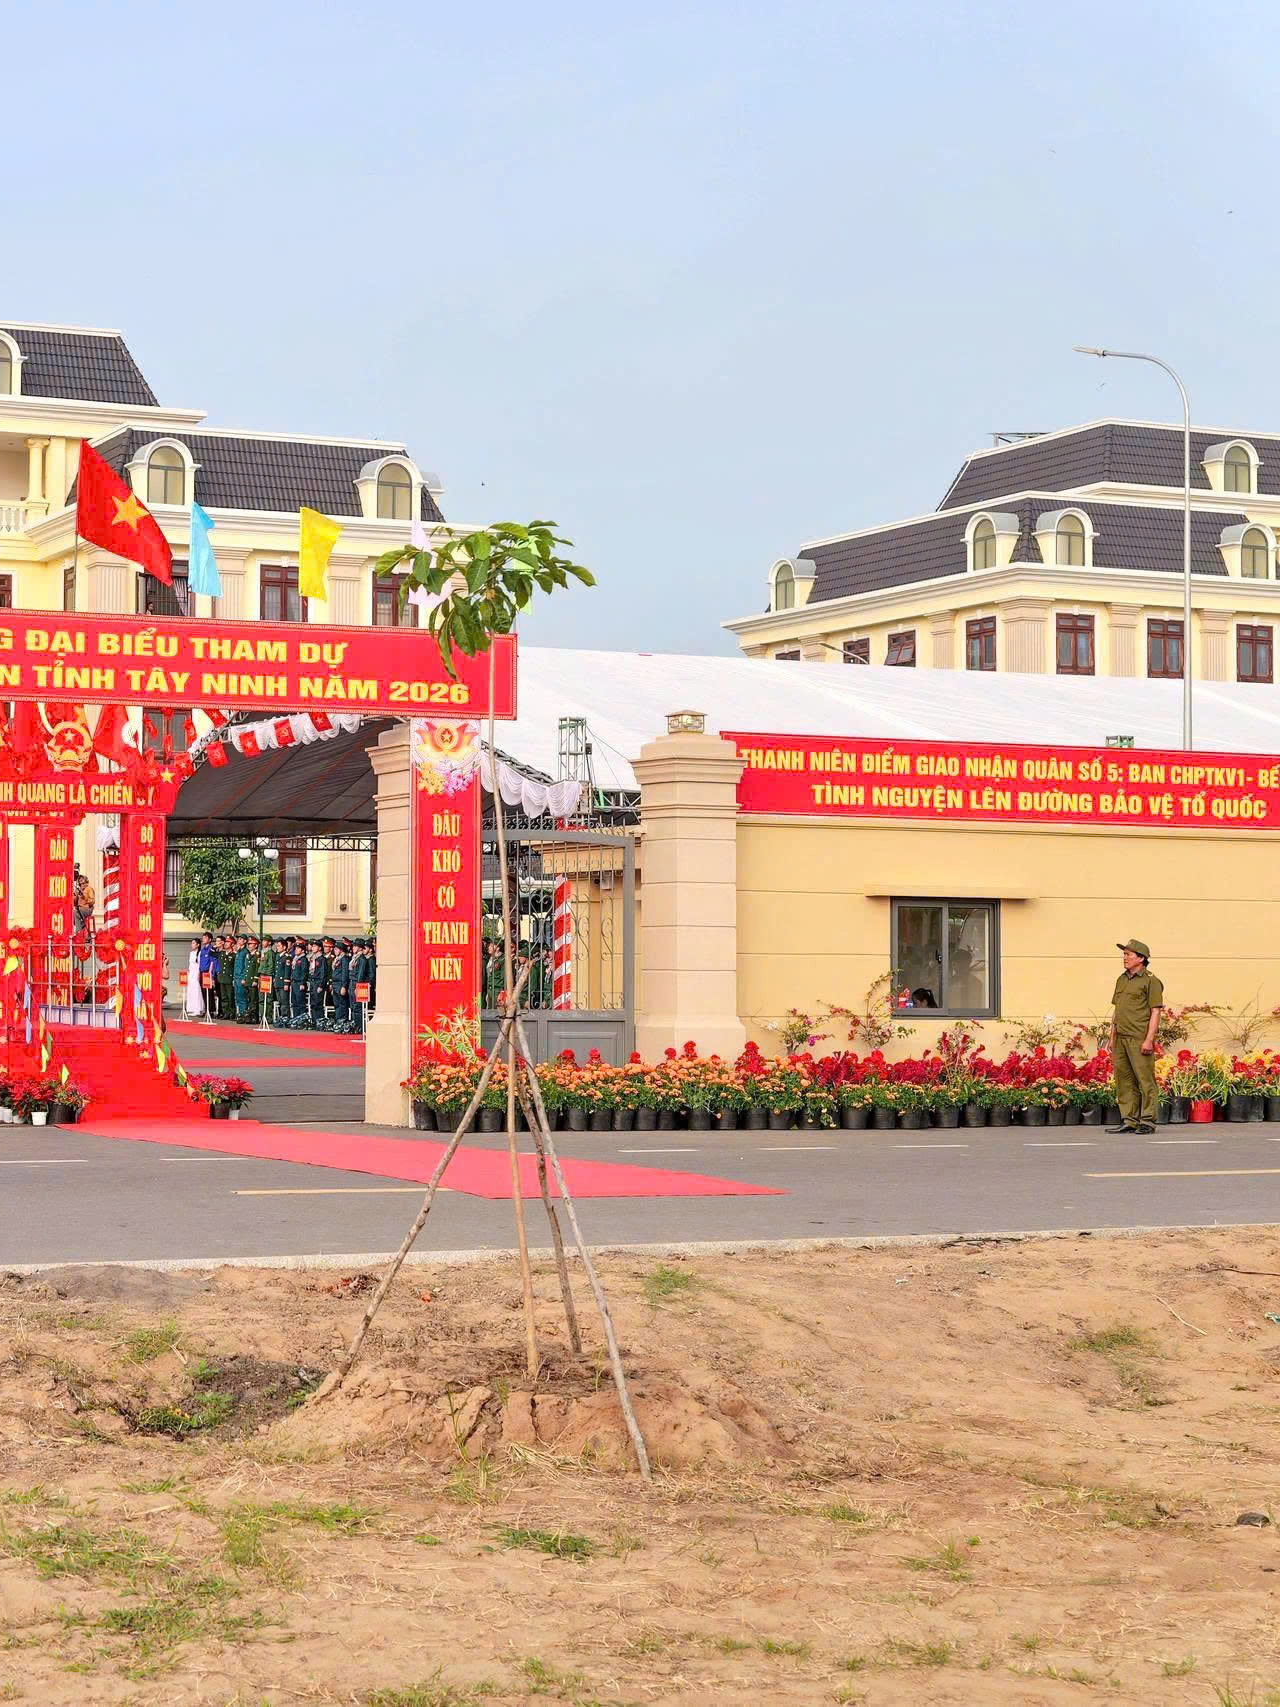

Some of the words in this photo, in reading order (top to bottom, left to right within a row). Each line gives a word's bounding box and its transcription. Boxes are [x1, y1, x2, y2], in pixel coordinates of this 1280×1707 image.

[24, 628, 86, 657] ĐẠI
[97, 627, 179, 657] BIỂU
[189, 637, 288, 663] THAM
[298, 641, 349, 669] DỰ
[31, 660, 115, 690] TỈNH
[124, 667, 191, 693] TÂY
[201, 672, 288, 697] NINH
[298, 675, 378, 701] NĂM
[388, 680, 471, 705] 2026
[740, 748, 804, 771] THANH
[809, 749, 857, 773] NIÊN
[862, 746, 911, 775] ĐIỂM
[915, 756, 960, 777] GIAO
[965, 754, 1017, 783] NHẬN
[1022, 757, 1073, 780] QUÂN
[1077, 755, 1104, 782] SỐ
[1106, 764, 1123, 783] 5:
[1128, 764, 1166, 784] BAN
[16, 782, 66, 804] QUANG
[69, 778, 87, 805] LÀ
[90, 778, 133, 806] CHIẾN
[811, 780, 865, 806] TÌNH
[871, 785, 963, 813] NGUYỆN
[970, 786, 1011, 811] LÊN
[1017, 788, 1093, 813] ĐƯỜNG
[1099, 788, 1143, 816] BẢO
[1148, 793, 1174, 820] VỆ
[1180, 790, 1207, 817] TỔ
[1211, 792, 1267, 819] QUỐC
[140, 822, 154, 848] BỘ
[432, 809, 461, 838] ĐÂU
[431, 845, 462, 874] KHÓ
[437, 881, 456, 910] CÓ
[423, 921, 469, 945] THANH
[430, 953, 463, 981] NIÊN
